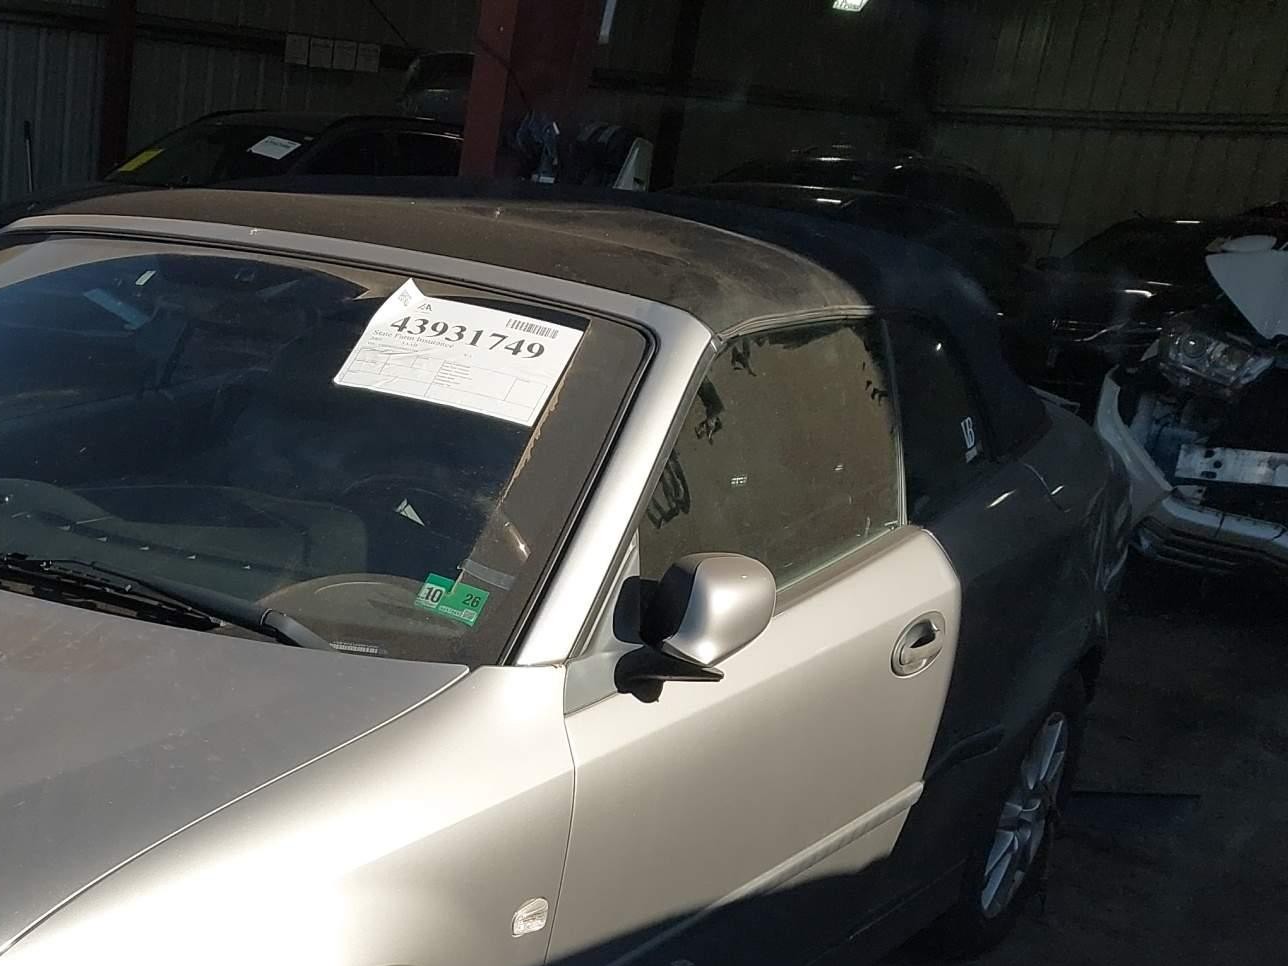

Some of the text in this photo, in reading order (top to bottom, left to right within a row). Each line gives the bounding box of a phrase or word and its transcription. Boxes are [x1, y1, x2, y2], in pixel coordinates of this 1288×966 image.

[390, 316, 545, 359] 43931749
[423, 586, 443, 604] 10
[462, 593, 481, 608] 26
